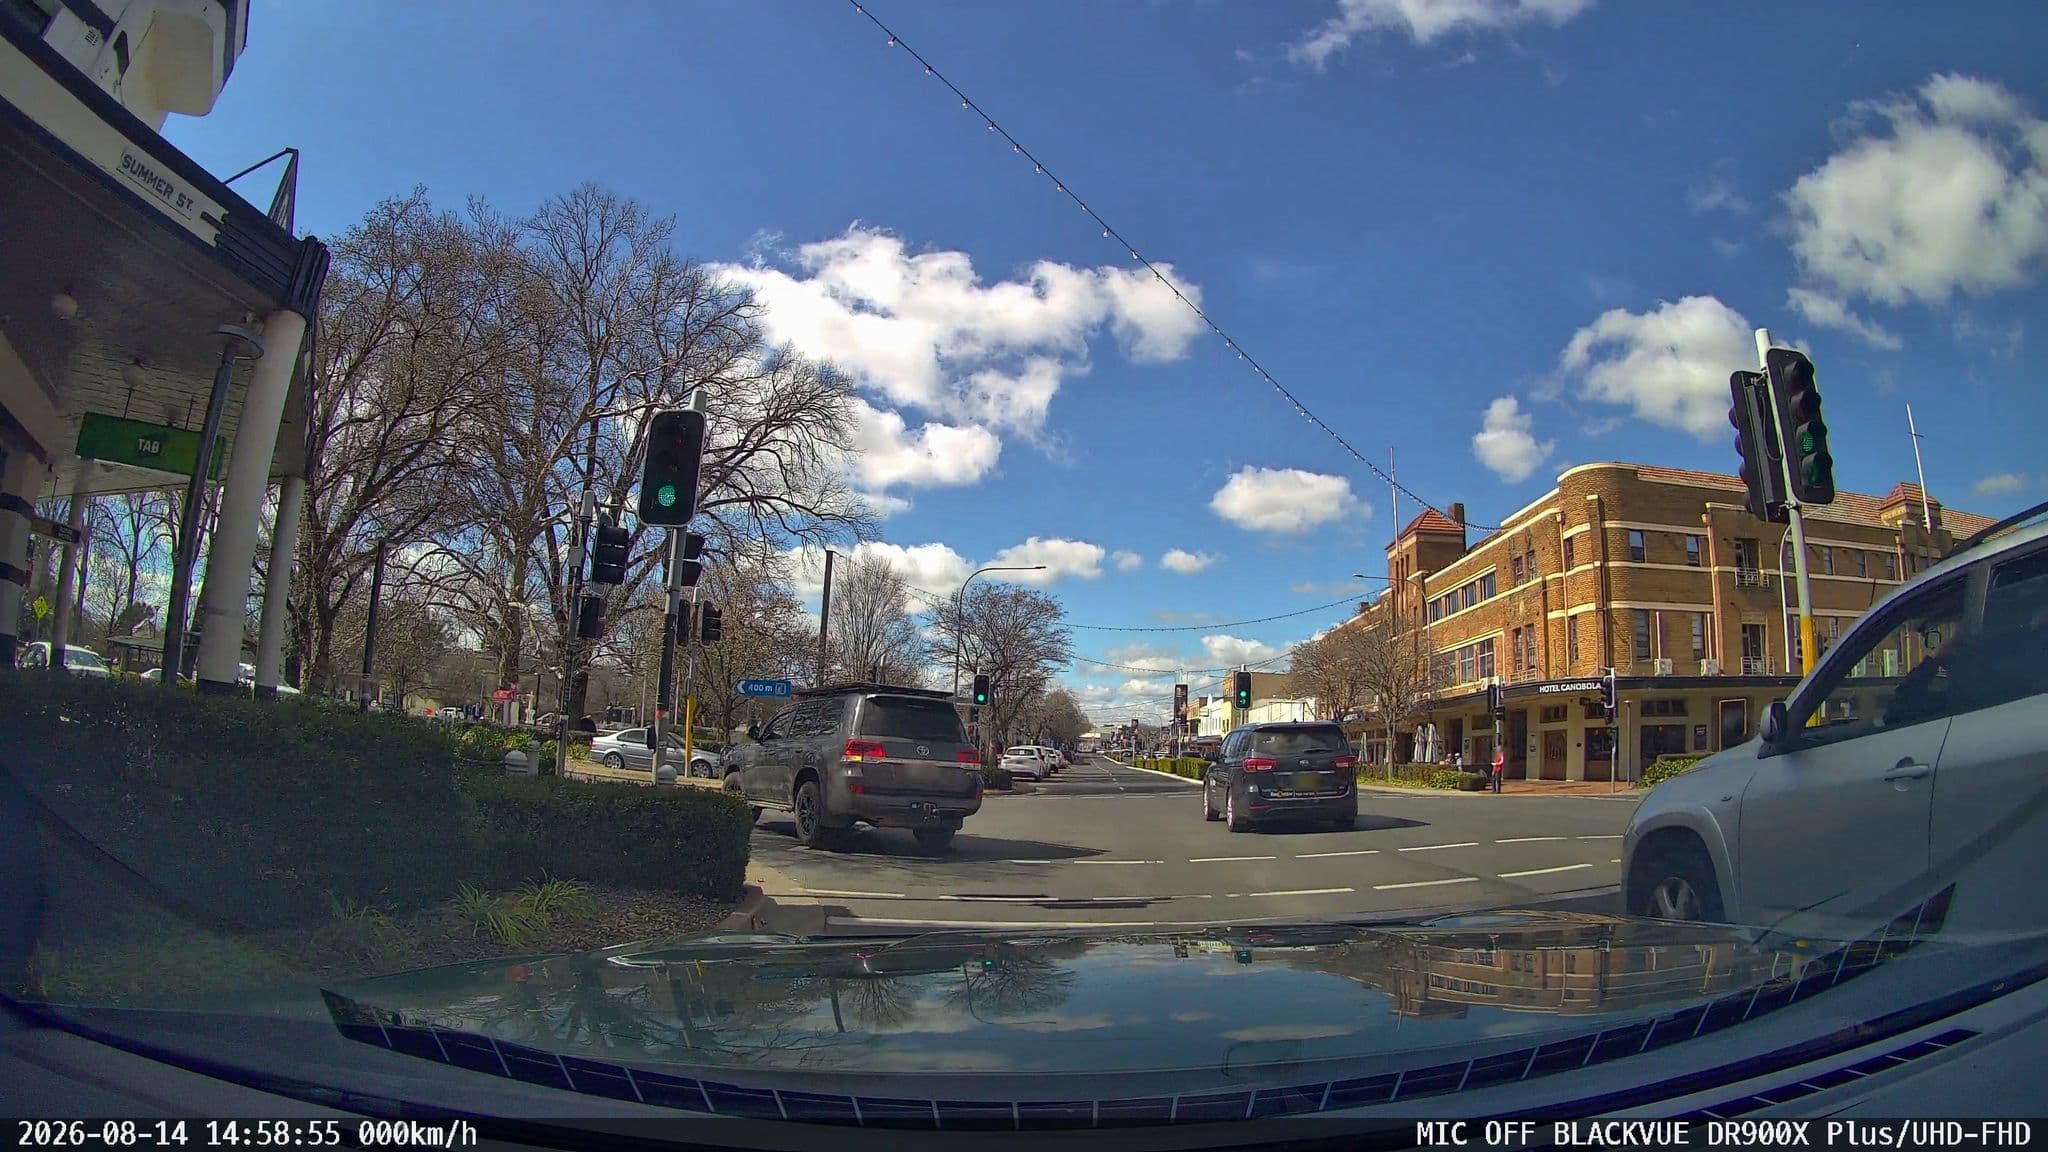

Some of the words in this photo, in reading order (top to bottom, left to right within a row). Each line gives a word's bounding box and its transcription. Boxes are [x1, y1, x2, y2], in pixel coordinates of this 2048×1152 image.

[121, 154, 174, 200] SUMMER
[175, 192, 195, 212] ST.
[138, 438, 160, 454] TAB
[1539, 685, 1560, 693] HOTEL
